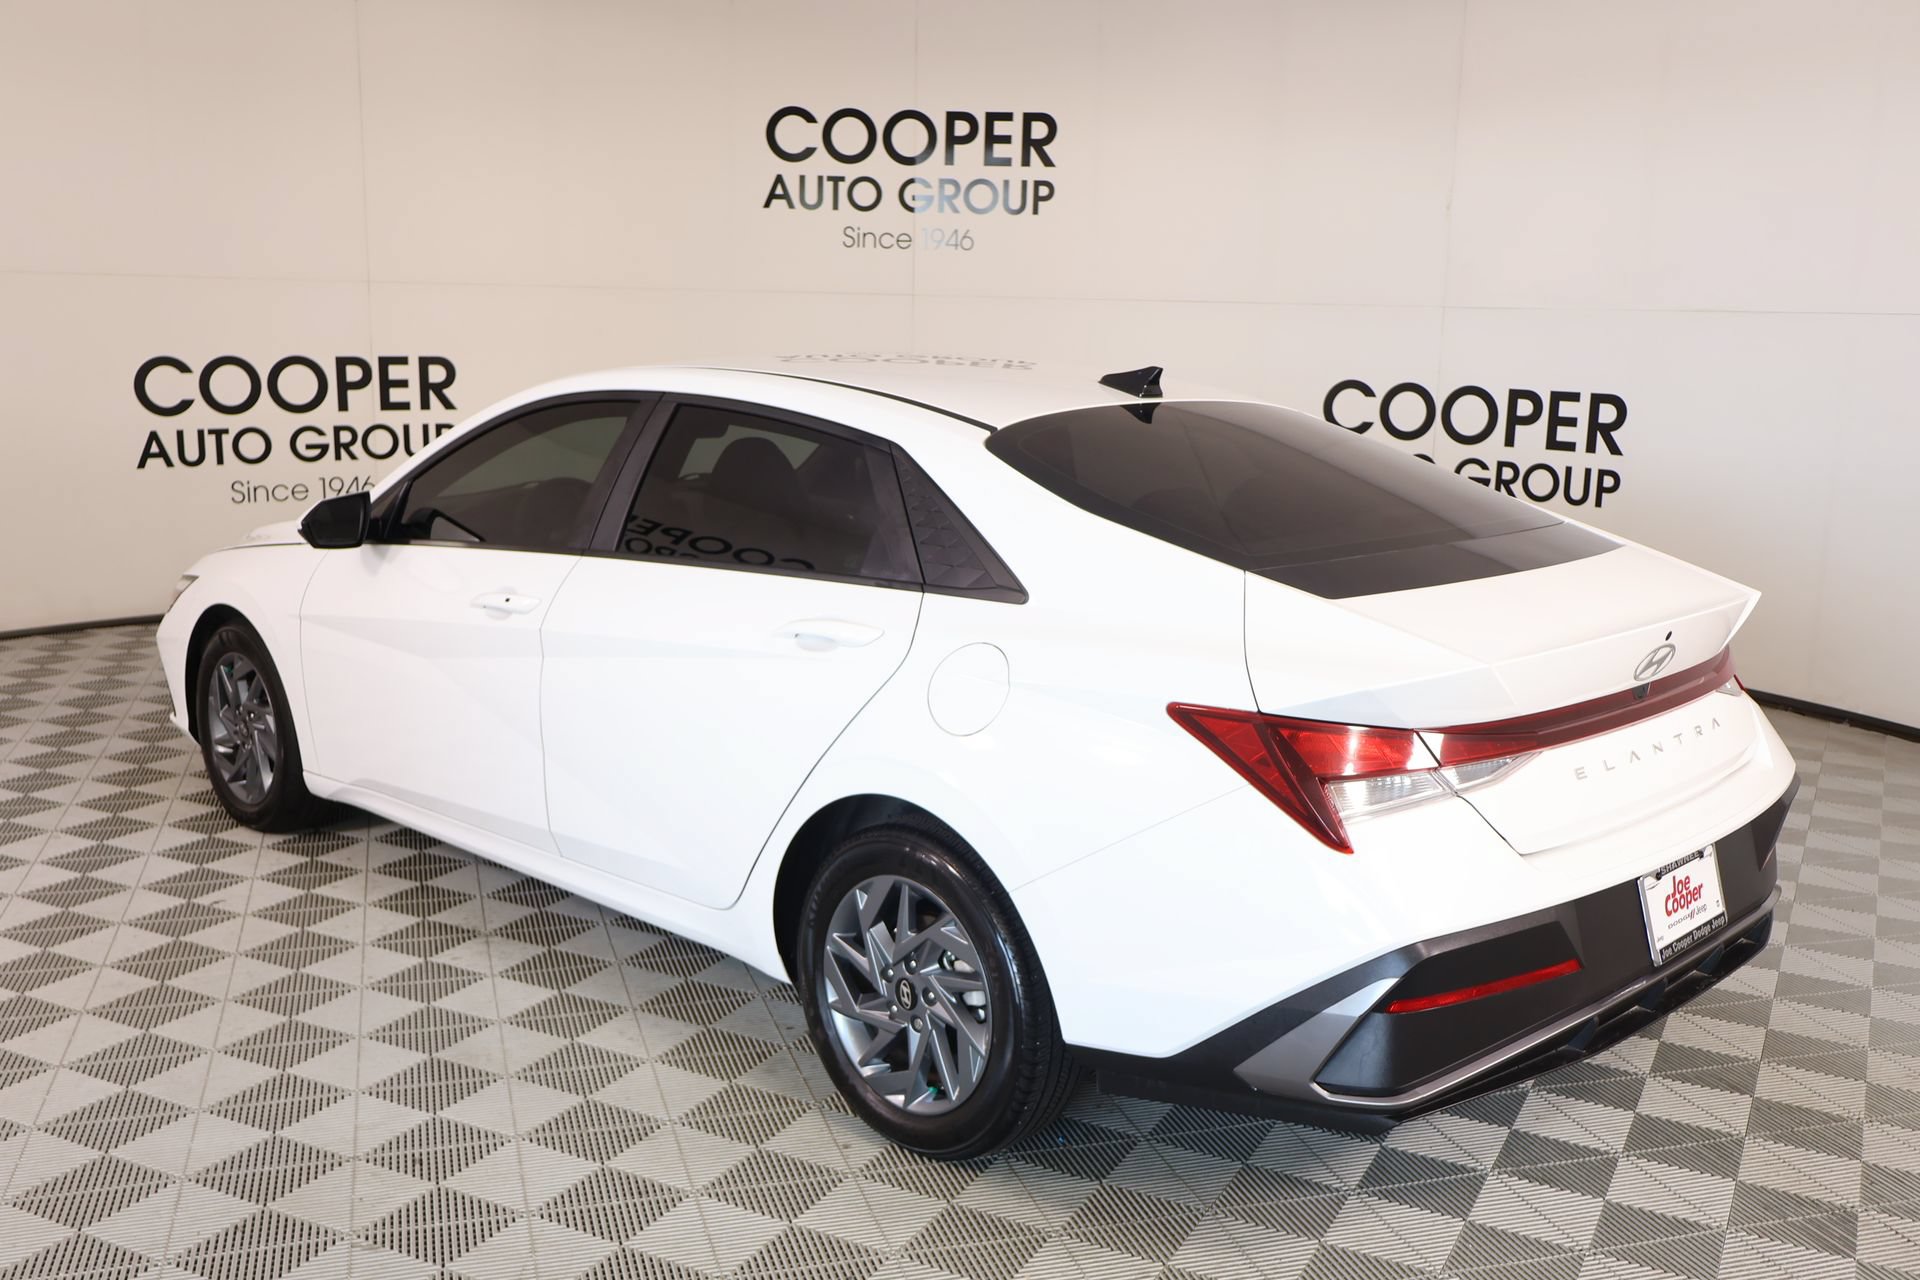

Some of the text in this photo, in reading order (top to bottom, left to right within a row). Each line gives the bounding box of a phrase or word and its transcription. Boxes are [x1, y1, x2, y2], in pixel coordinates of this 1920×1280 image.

[766, 106, 1058, 168] COOPER
[763, 174, 1055, 216] AUTO GROUP
[842, 225, 975, 251] Since 1946
[133, 355, 458, 417] COOPER
[1323, 379, 1628, 456] COOPER
[136, 426, 273, 469] AUTO
[230, 480, 309, 504] Since
[1454, 457, 1621, 509] GROUP
[1573, 717, 1721, 781] ELANTRA
[1660, 849, 1701, 875] SHAWNEE
[1664, 882, 1704, 917] Cooper
[1671, 875, 1691, 899] Joe
[1661, 947, 1673, 960] Joe
[1672, 934, 1693, 953] Cooper
[1692, 923, 1711, 940] Dodge
[1711, 915, 1725, 929] Jeep
